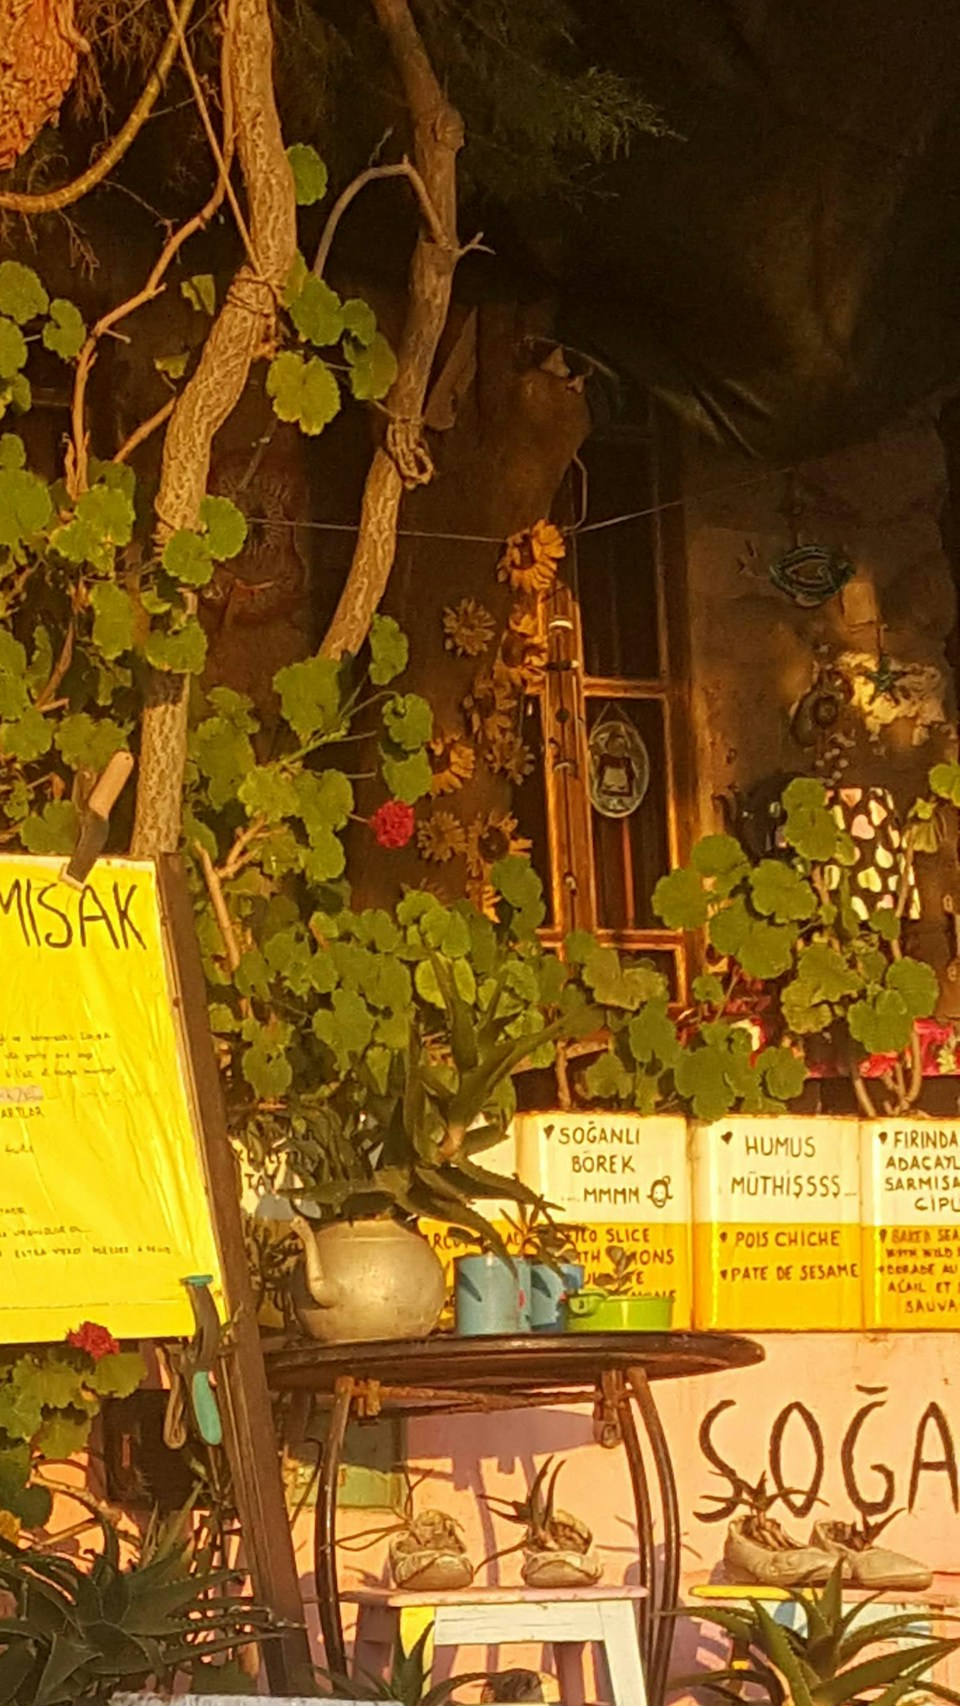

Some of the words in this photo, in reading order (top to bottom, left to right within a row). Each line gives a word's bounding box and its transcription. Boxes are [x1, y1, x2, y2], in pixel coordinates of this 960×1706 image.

[559, 1121, 640, 1145] SOĞANLI
[894, 1129, 959, 1149] FIRINDA
[744, 1135, 816, 1158] HUMUS
[572, 1151, 636, 1174] BÖREK
[606, 1227, 650, 1243] SLICE
[735, 1231, 768, 1248] POIS
[775, 1230, 840, 1247] CHICHE
[731, 1265, 768, 1282] PATE
[776, 1264, 793, 1281] DE
[800, 1262, 859, 1281] SESAME
